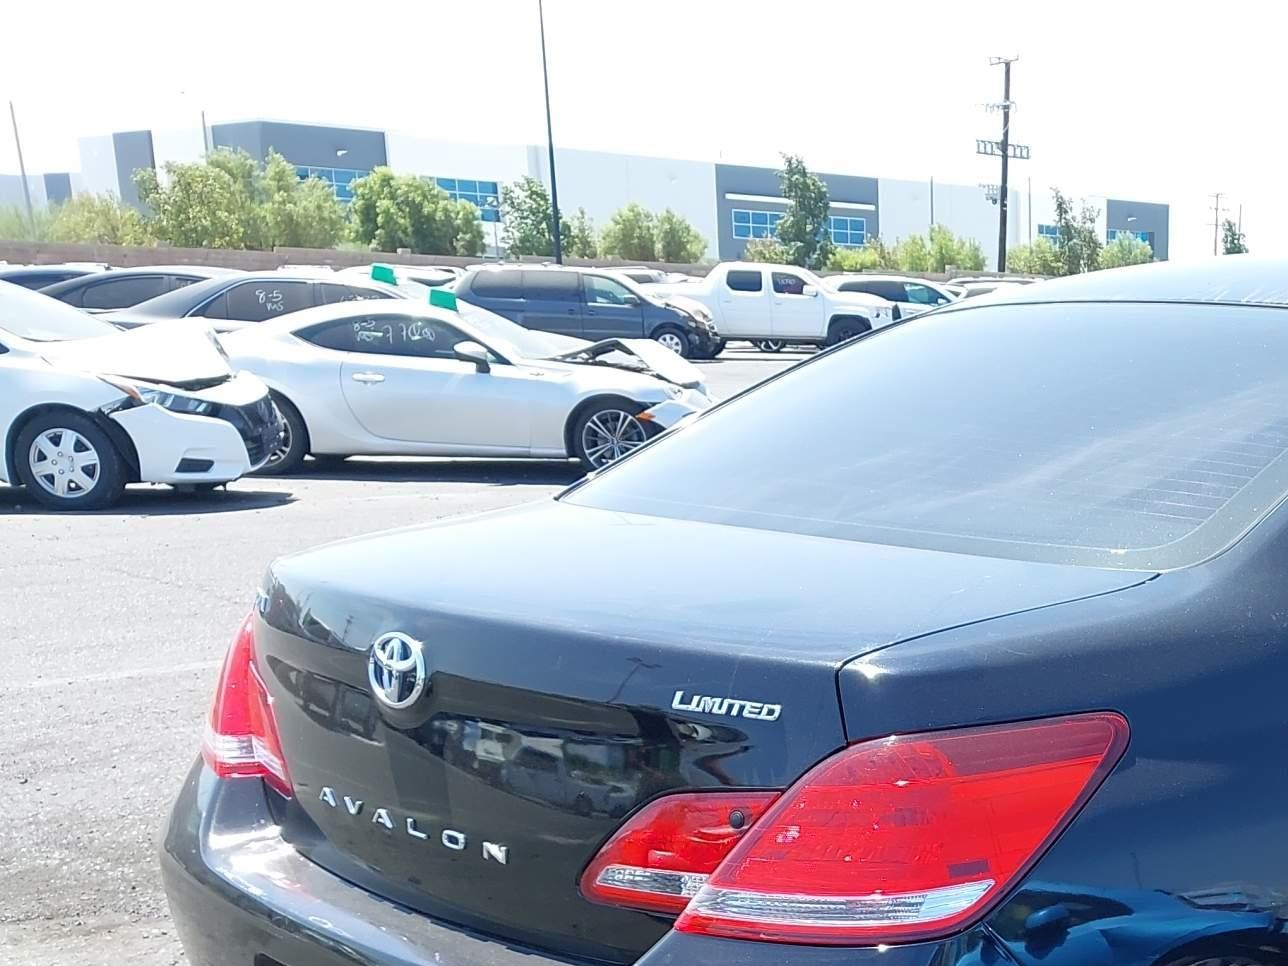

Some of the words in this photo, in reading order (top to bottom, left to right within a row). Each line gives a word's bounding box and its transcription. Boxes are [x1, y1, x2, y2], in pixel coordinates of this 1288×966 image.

[255, 289, 283, 304] 8-5
[672, 690, 782, 722] LIMITED
[319, 786, 510, 865] AVALON
